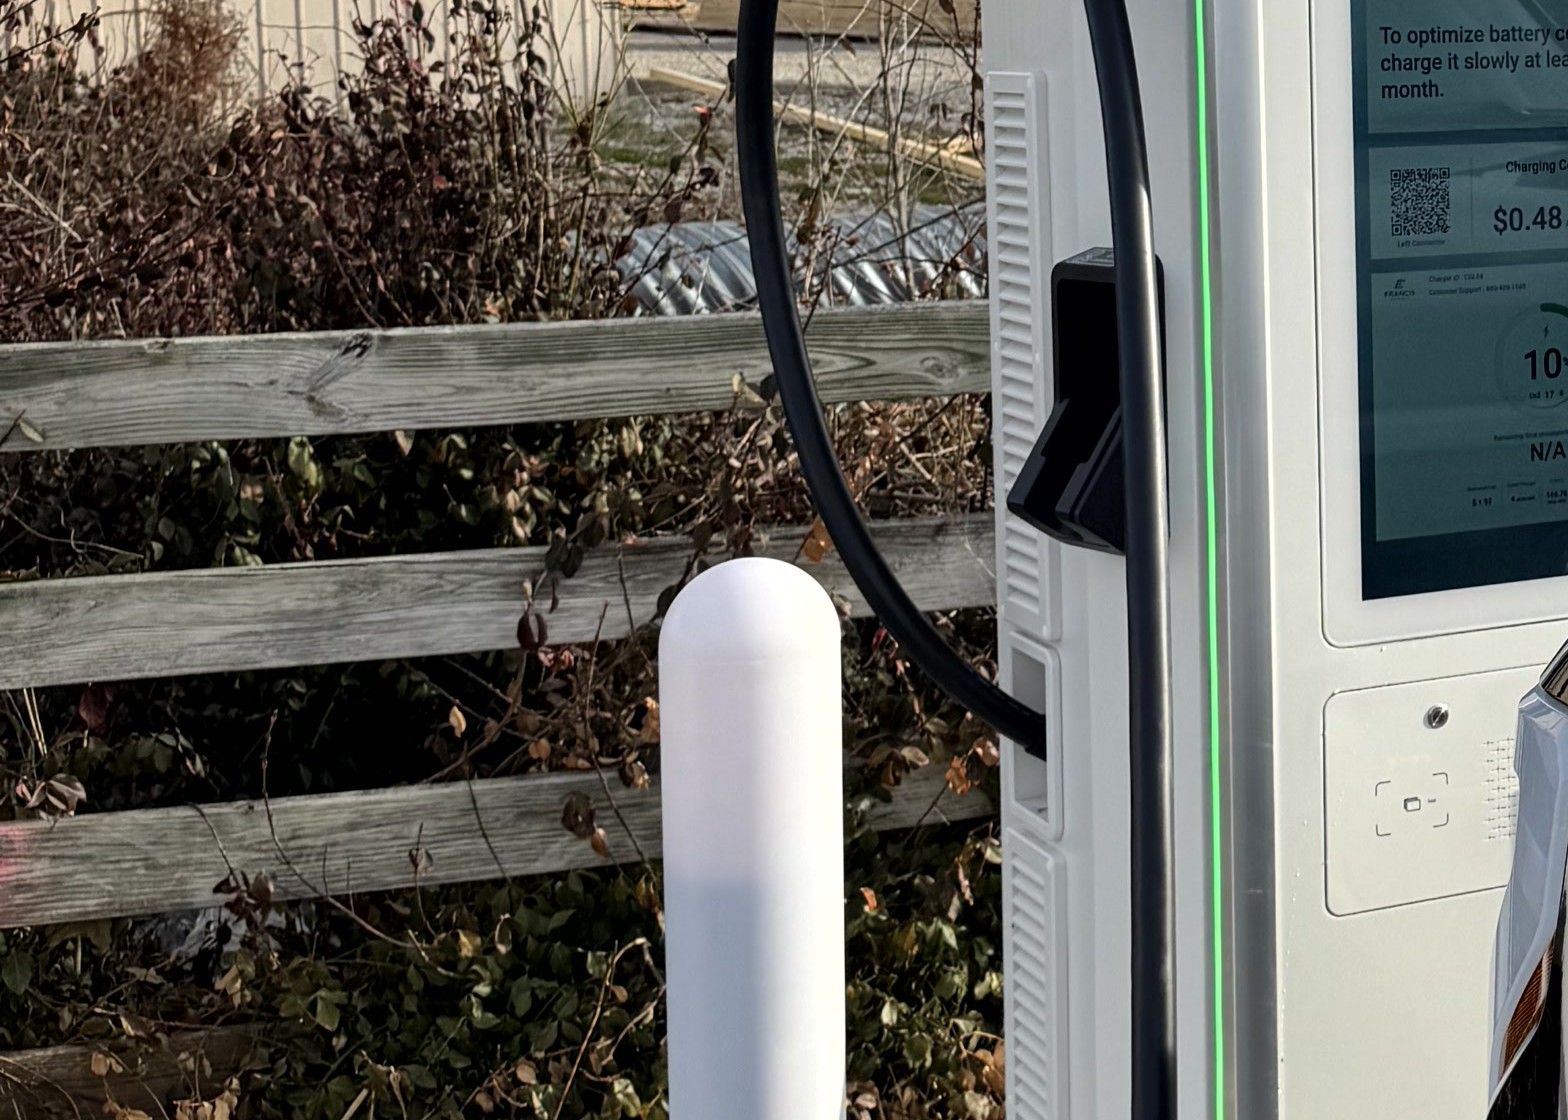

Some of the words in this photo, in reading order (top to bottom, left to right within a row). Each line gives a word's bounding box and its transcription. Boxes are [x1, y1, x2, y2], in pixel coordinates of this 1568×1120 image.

[1380, 26, 1401, 44] To
[1407, 26, 1484, 48] optimize
[1489, 25, 1550, 47] battery
[1380, 53, 1442, 75] charge
[1448, 53, 1459, 70] it
[1464, 50, 1519, 73] slowly
[1525, 52, 1541, 68] at
[1381, 80, 1444, 98] month.
[1505, 159, 1556, 177] Charging
[1493, 205, 1563, 236] $0.48
[1530, 441, 1566, 462] N/A
